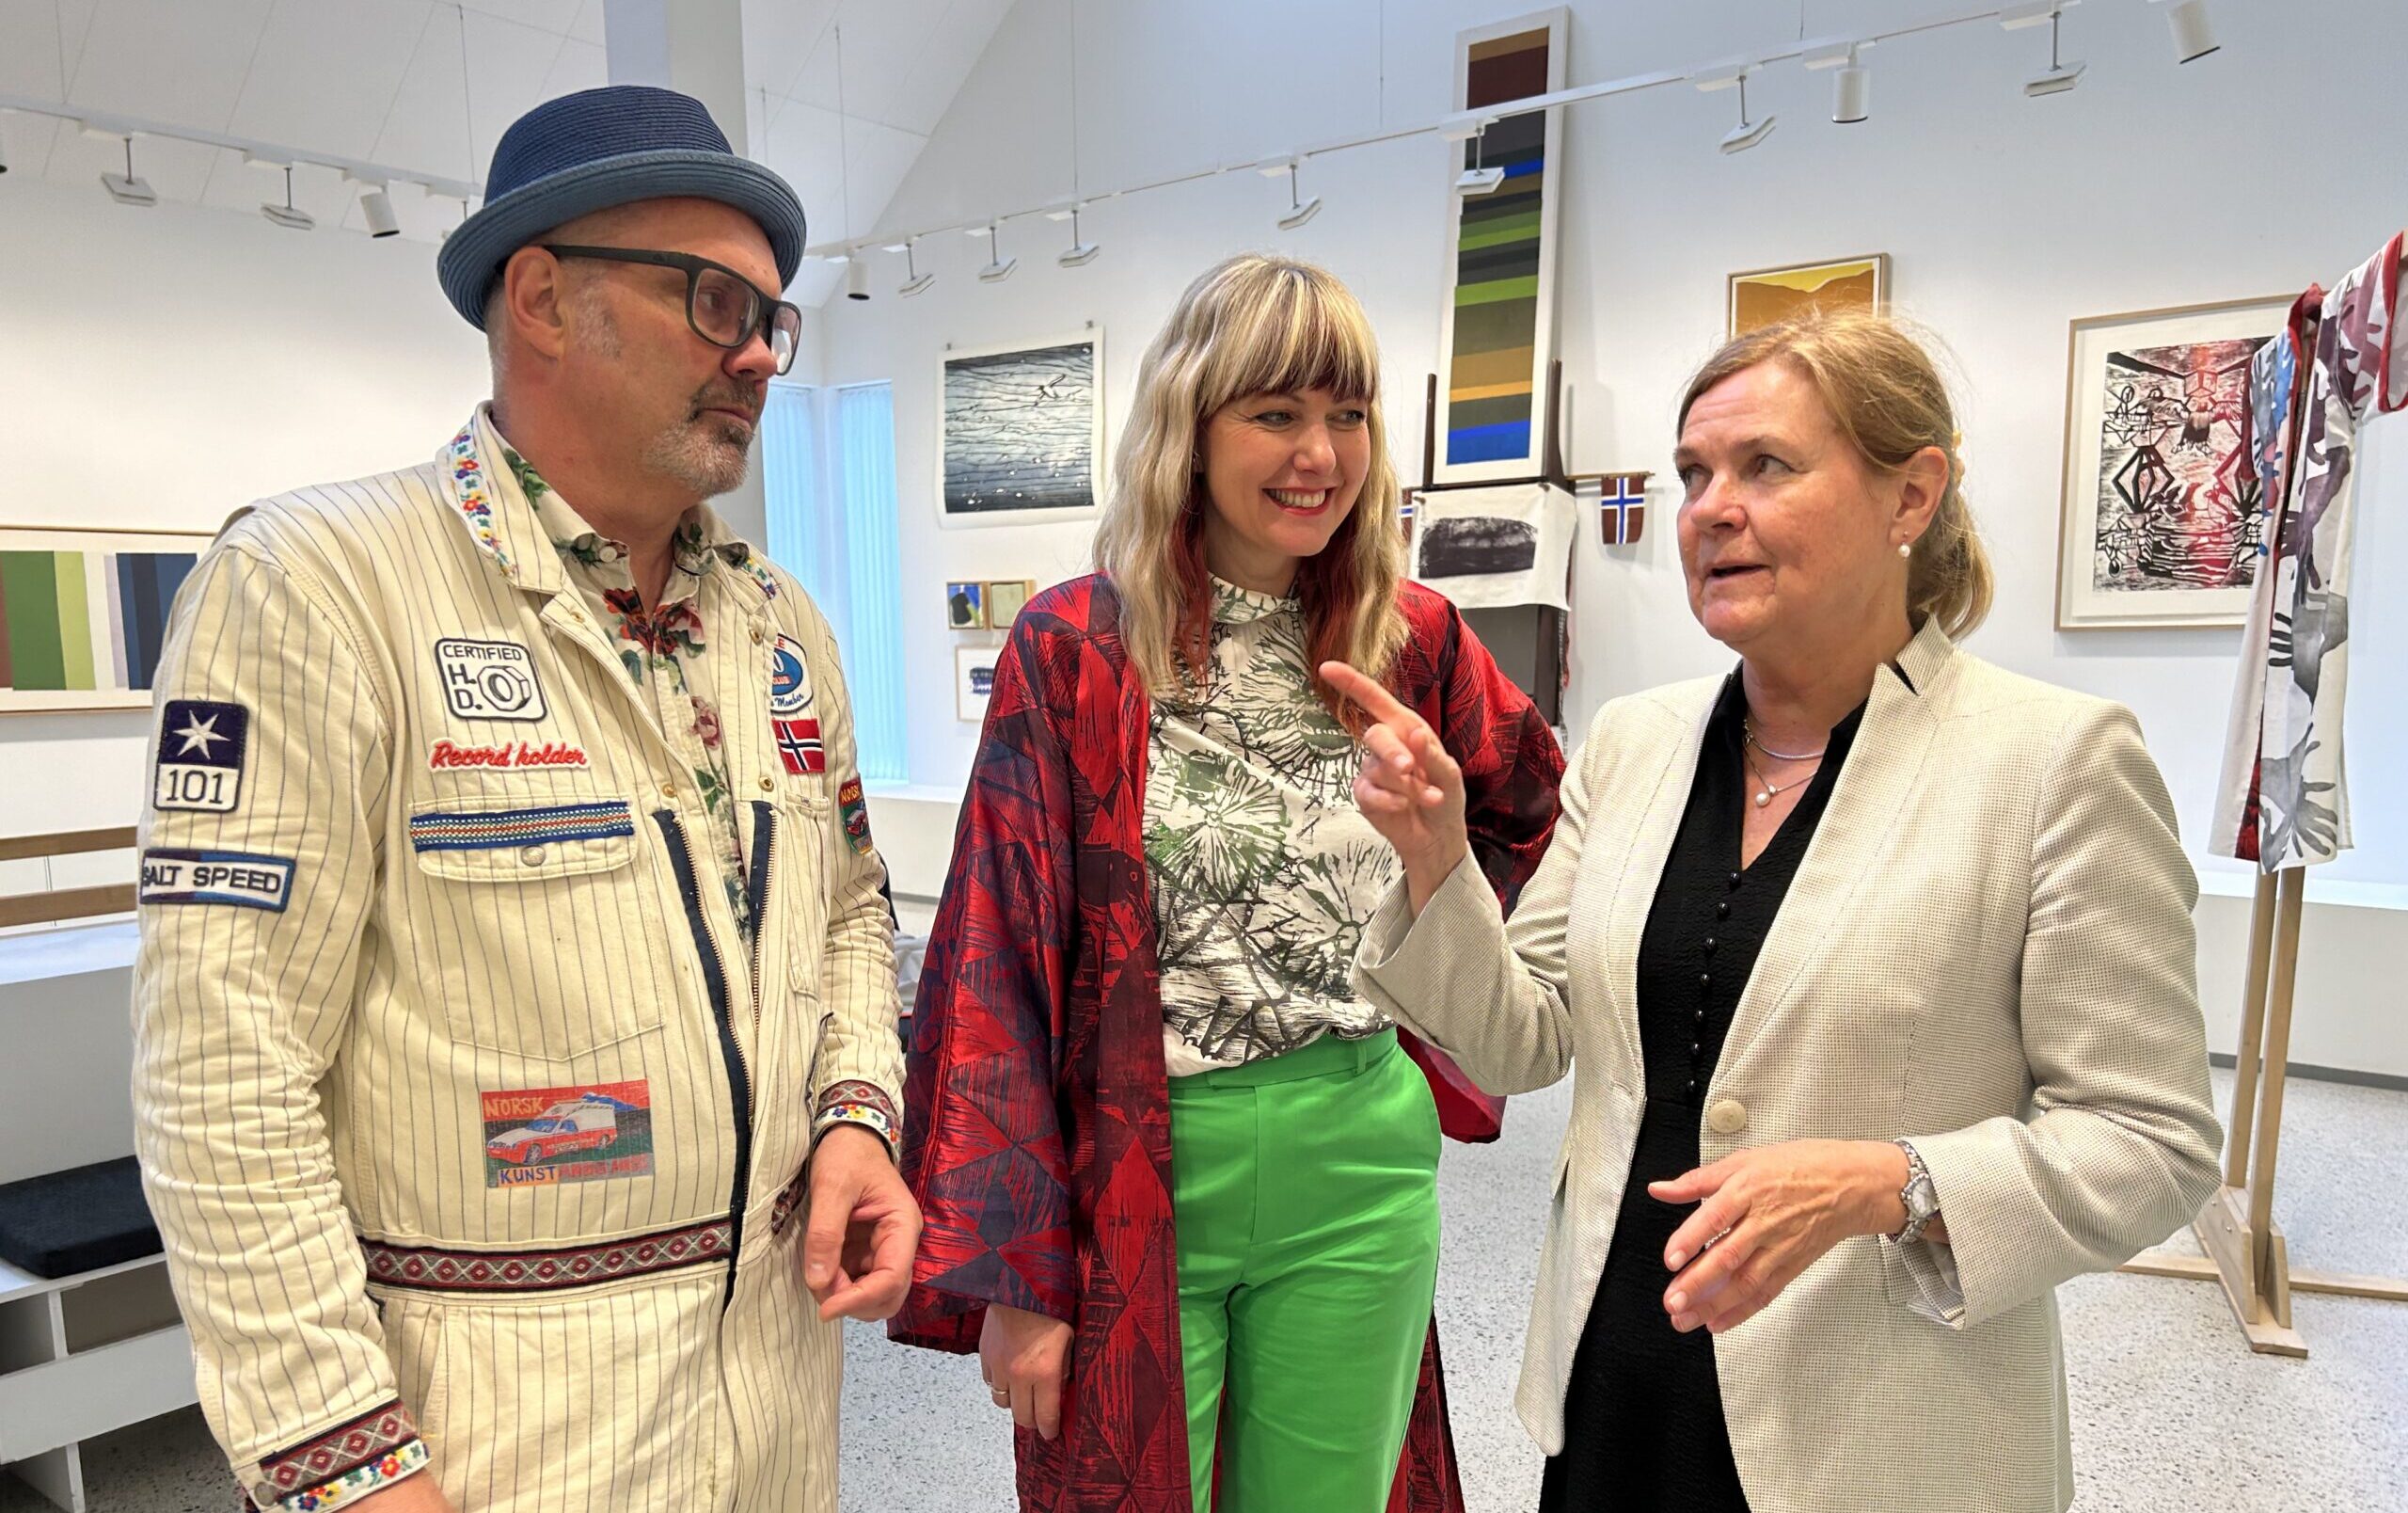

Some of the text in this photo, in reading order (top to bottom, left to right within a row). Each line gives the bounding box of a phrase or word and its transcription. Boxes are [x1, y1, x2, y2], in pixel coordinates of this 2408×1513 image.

[443, 644, 522, 661] CERTIFIED
[432, 741, 512, 768] Record
[515, 741, 586, 767] holder
[166, 769, 224, 804] 101
[193, 866, 281, 894] SPEED
[483, 1095, 544, 1118] NORSK
[500, 1166, 556, 1185] KUNST
